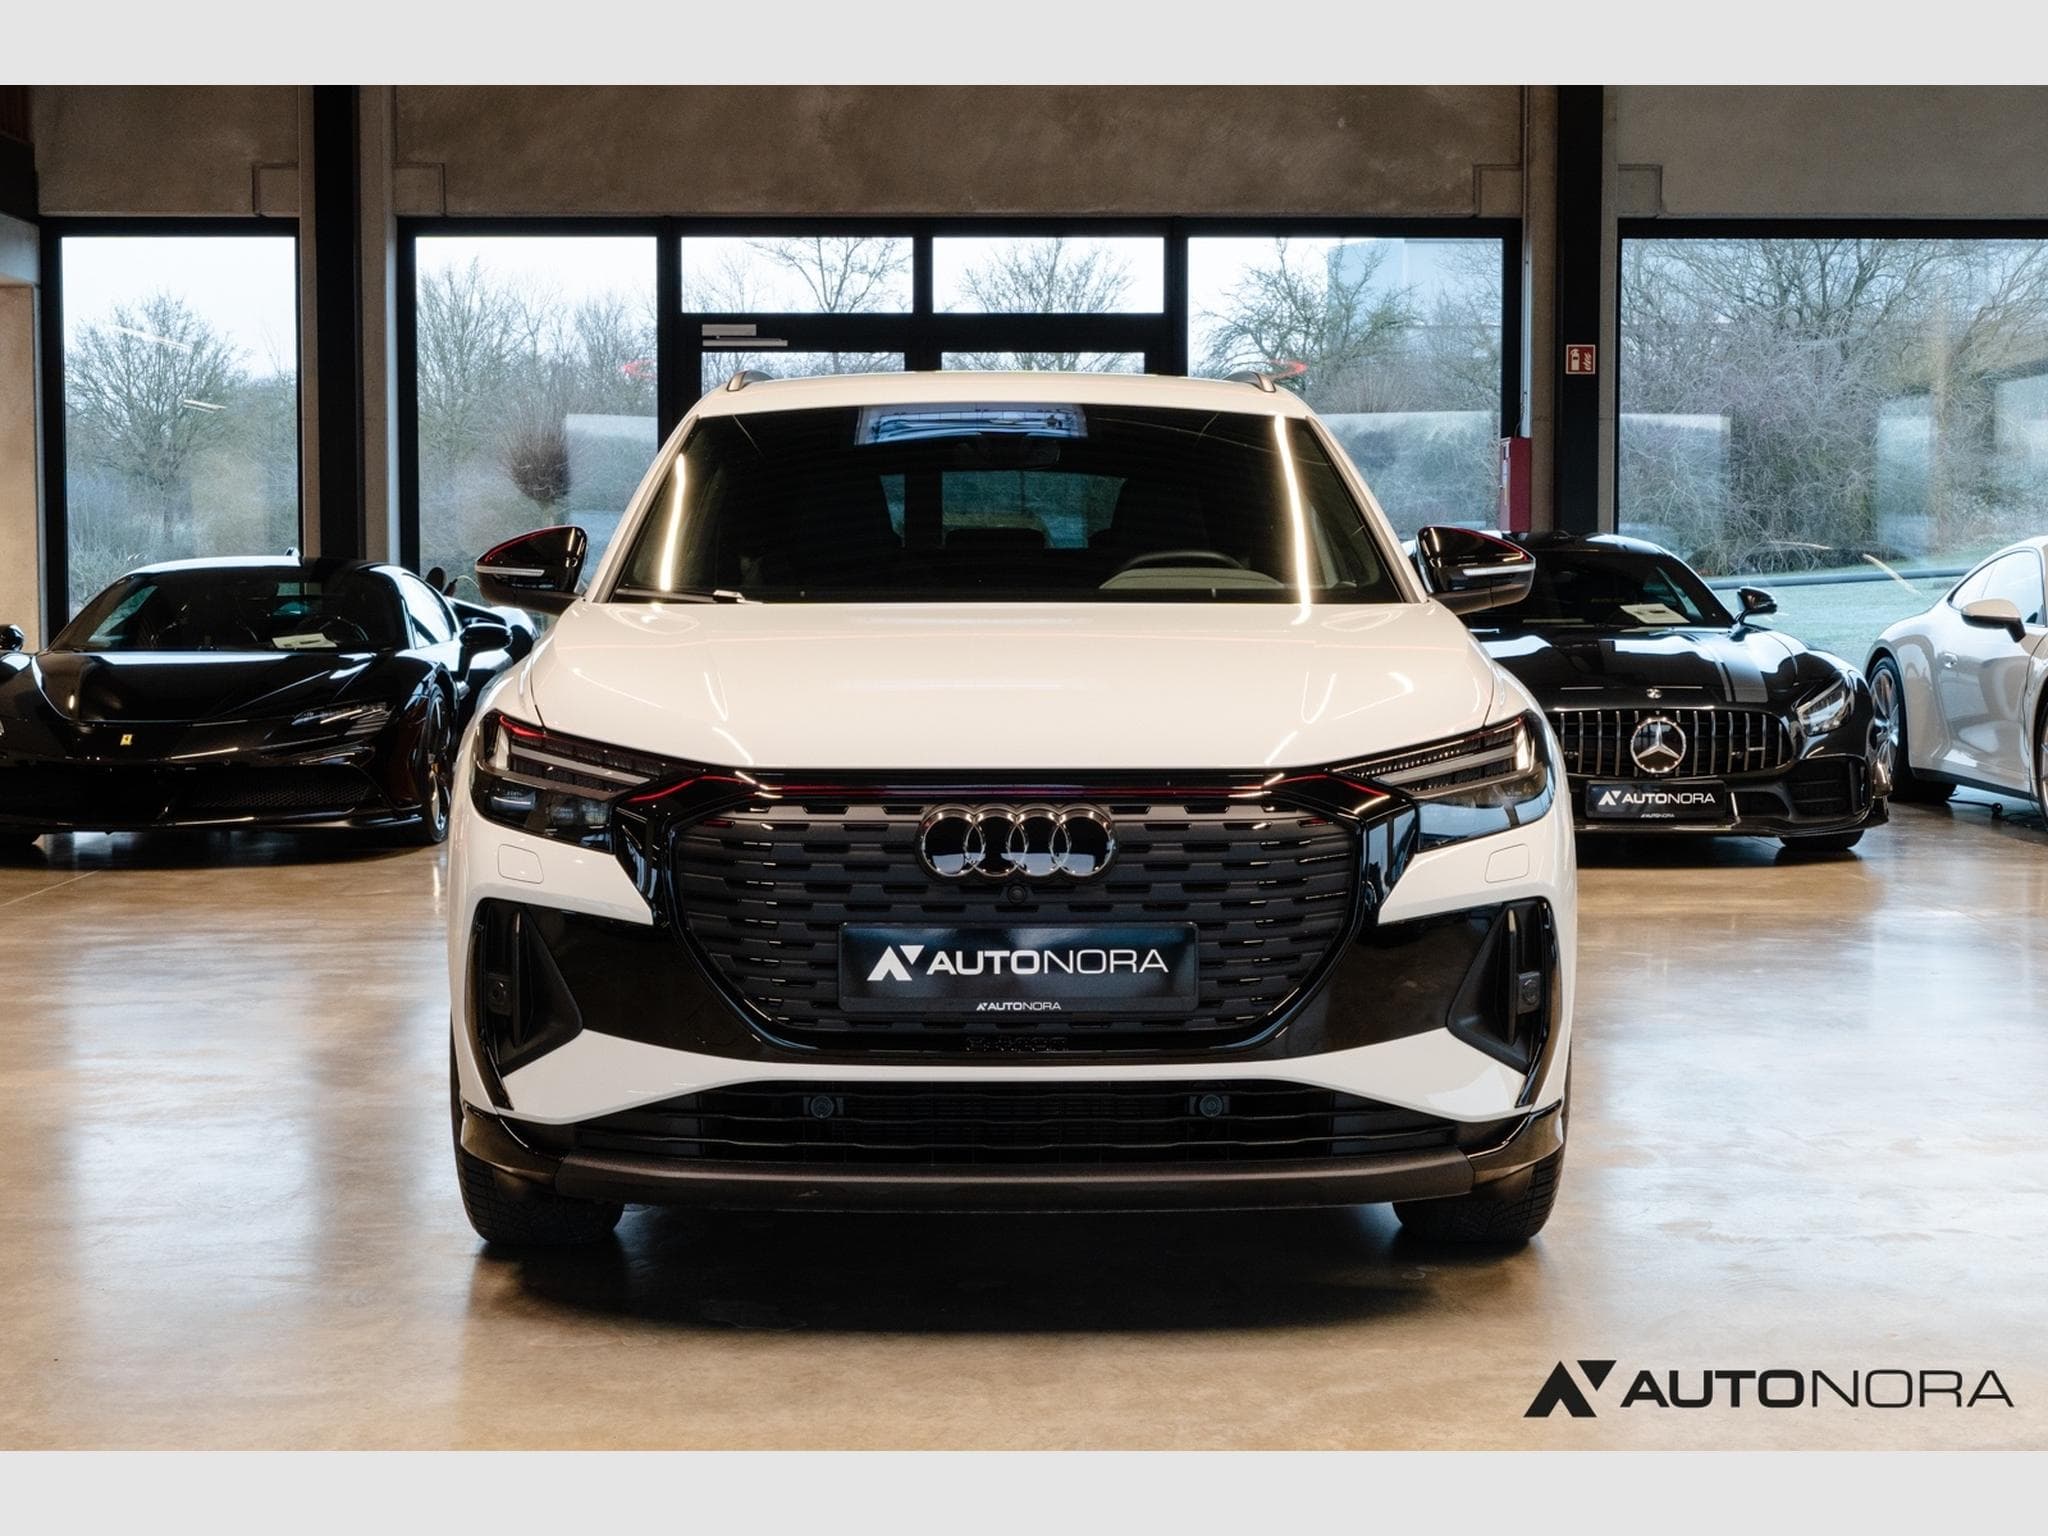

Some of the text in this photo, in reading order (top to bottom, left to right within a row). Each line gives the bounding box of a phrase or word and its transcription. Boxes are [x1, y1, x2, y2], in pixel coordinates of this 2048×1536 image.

[1621, 792, 1716, 805] AUTONORA
[926, 949, 1169, 975] AUTONORA
[987, 1002, 1062, 1011] AUTONORA
